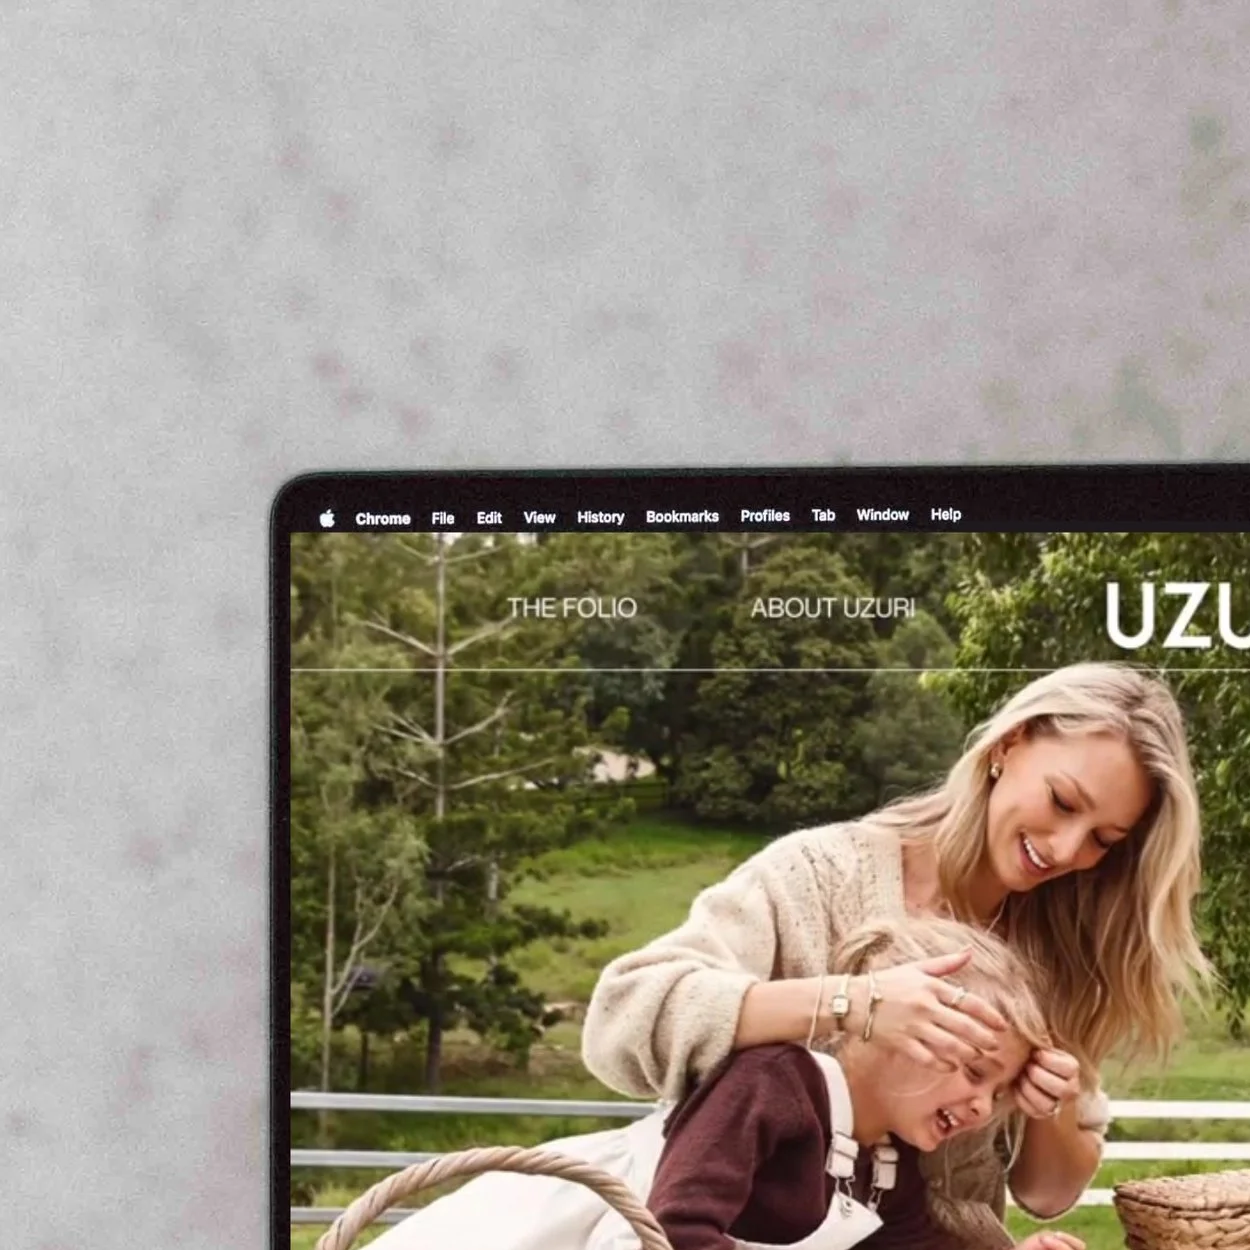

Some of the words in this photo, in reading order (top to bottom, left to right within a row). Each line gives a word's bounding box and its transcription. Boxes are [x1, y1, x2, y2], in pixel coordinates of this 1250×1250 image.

[355, 511, 412, 526] Chrome
[431, 511, 455, 525] File
[476, 510, 503, 525] Edit
[523, 510, 557, 524] View
[577, 510, 626, 526] History
[646, 509, 720, 524] Bookmarks
[740, 508, 791, 523] Profiles
[811, 508, 836, 522] Tab
[856, 507, 910, 521] Window
[931, 507, 962, 523] Help
[509, 597, 556, 618] THE
[563, 597, 638, 618] FOLIO
[751, 597, 837, 618] ABOUT
[844, 597, 915, 618] UZURI
